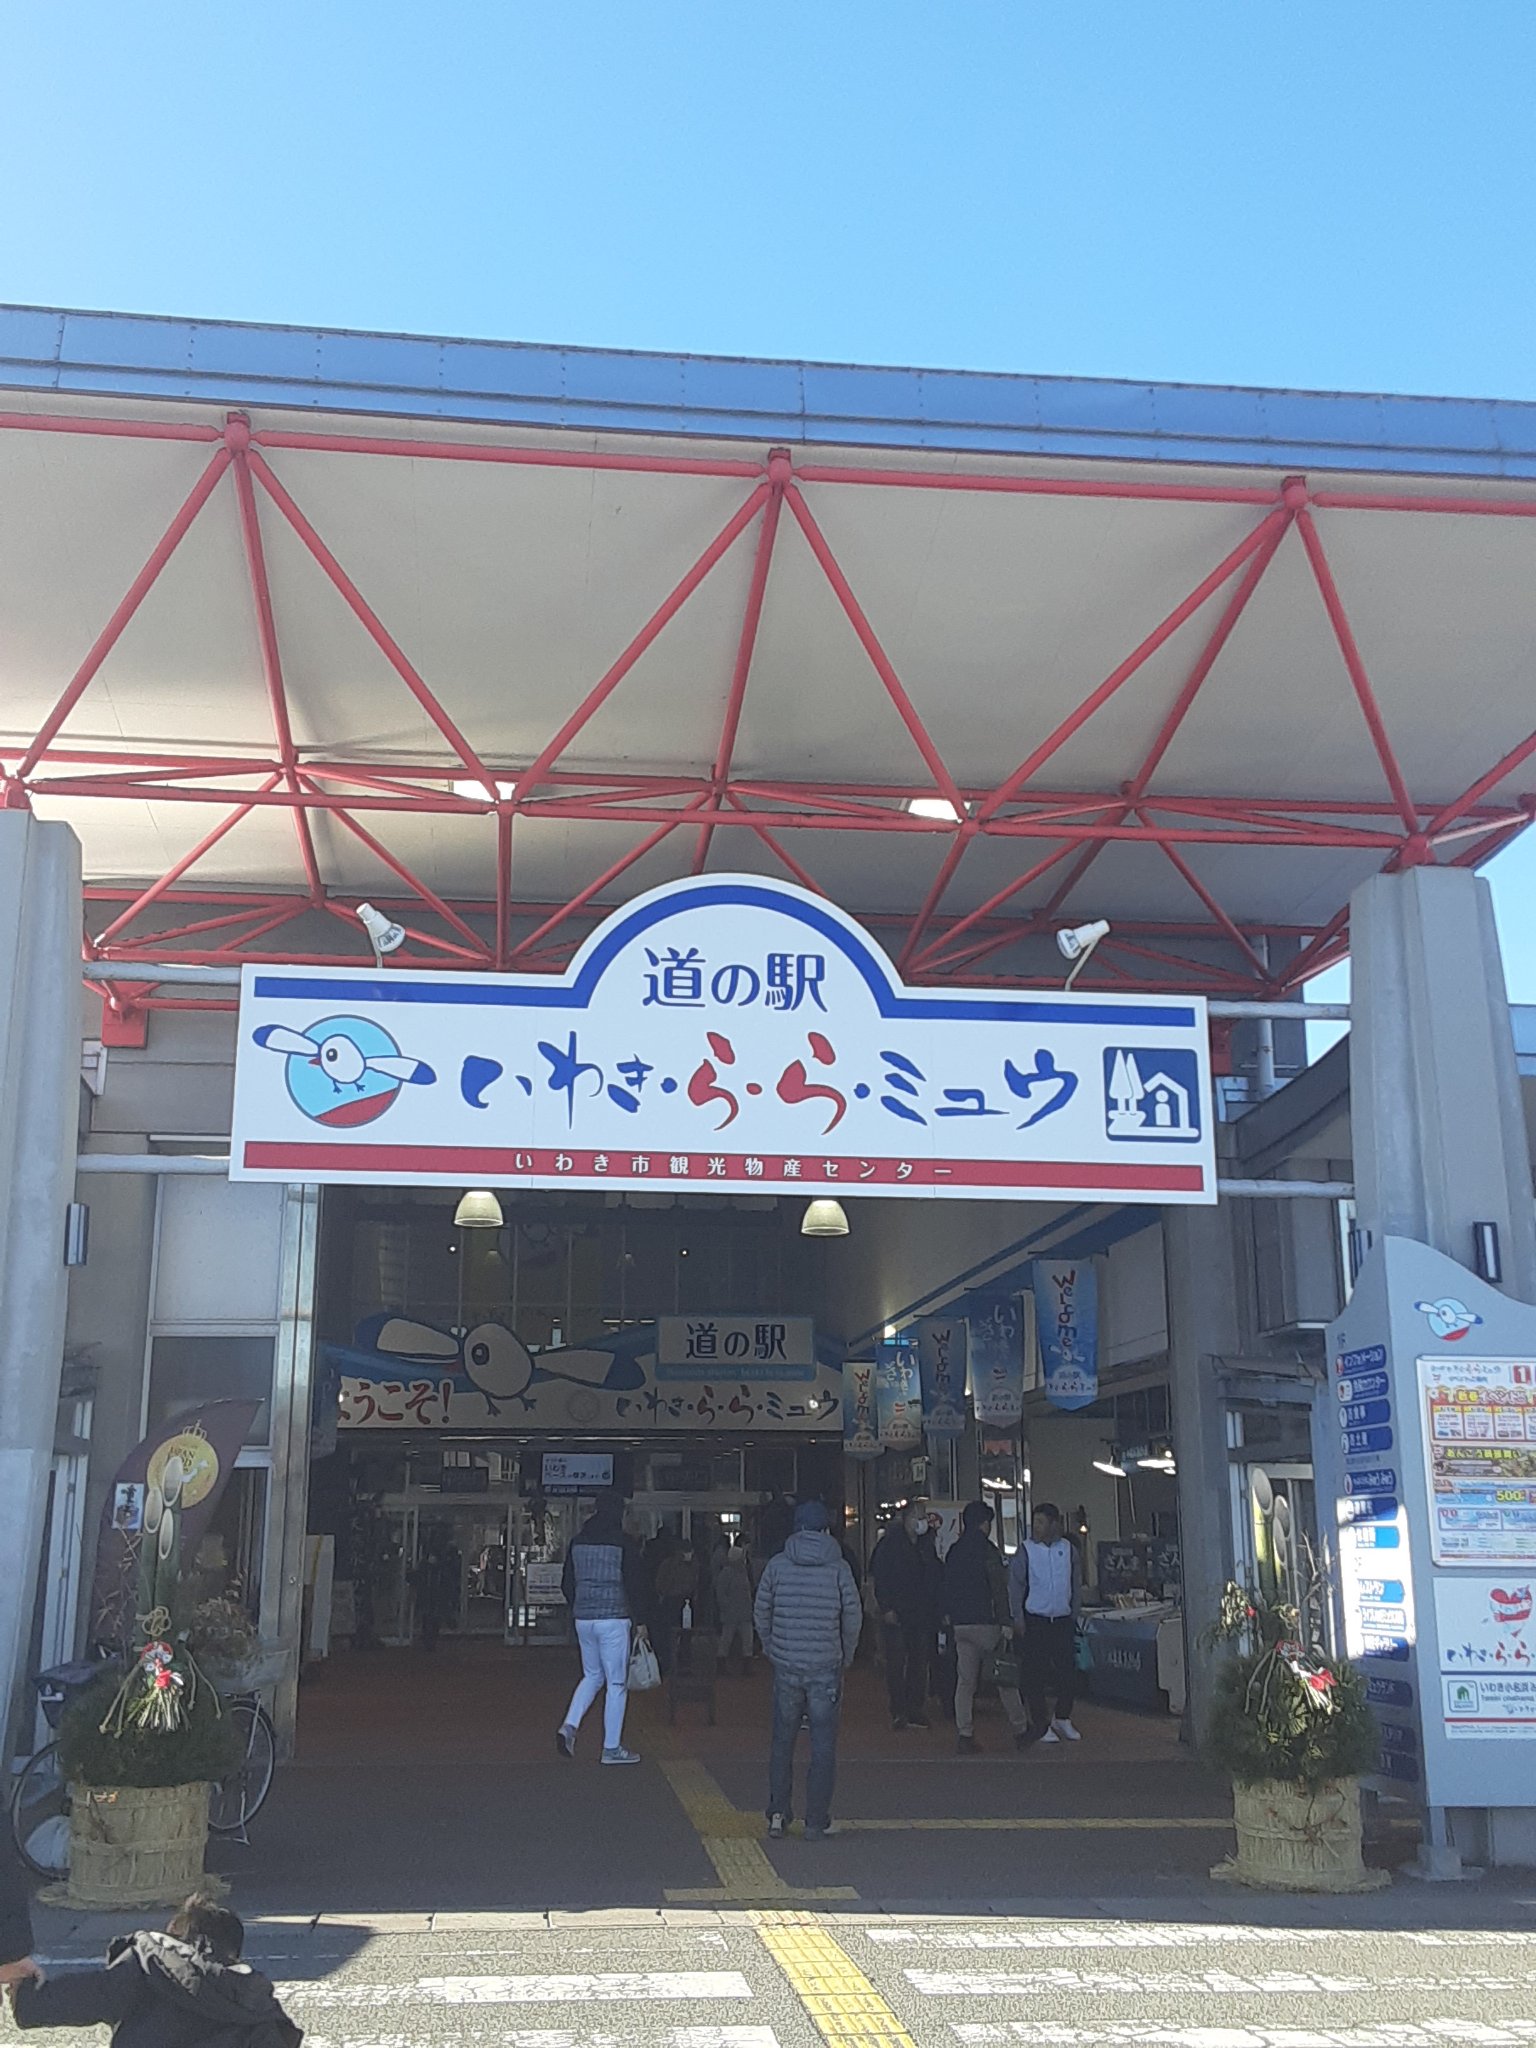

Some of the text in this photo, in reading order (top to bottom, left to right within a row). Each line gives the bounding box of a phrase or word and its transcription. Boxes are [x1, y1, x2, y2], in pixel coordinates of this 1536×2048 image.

[642, 946, 828, 1013] 道の駅
[514, 1152, 953, 1179] いわき市観光物産センター
[1051, 1269, 1078, 1348] Welcome
[685, 1322, 788, 1361] 道の駅
